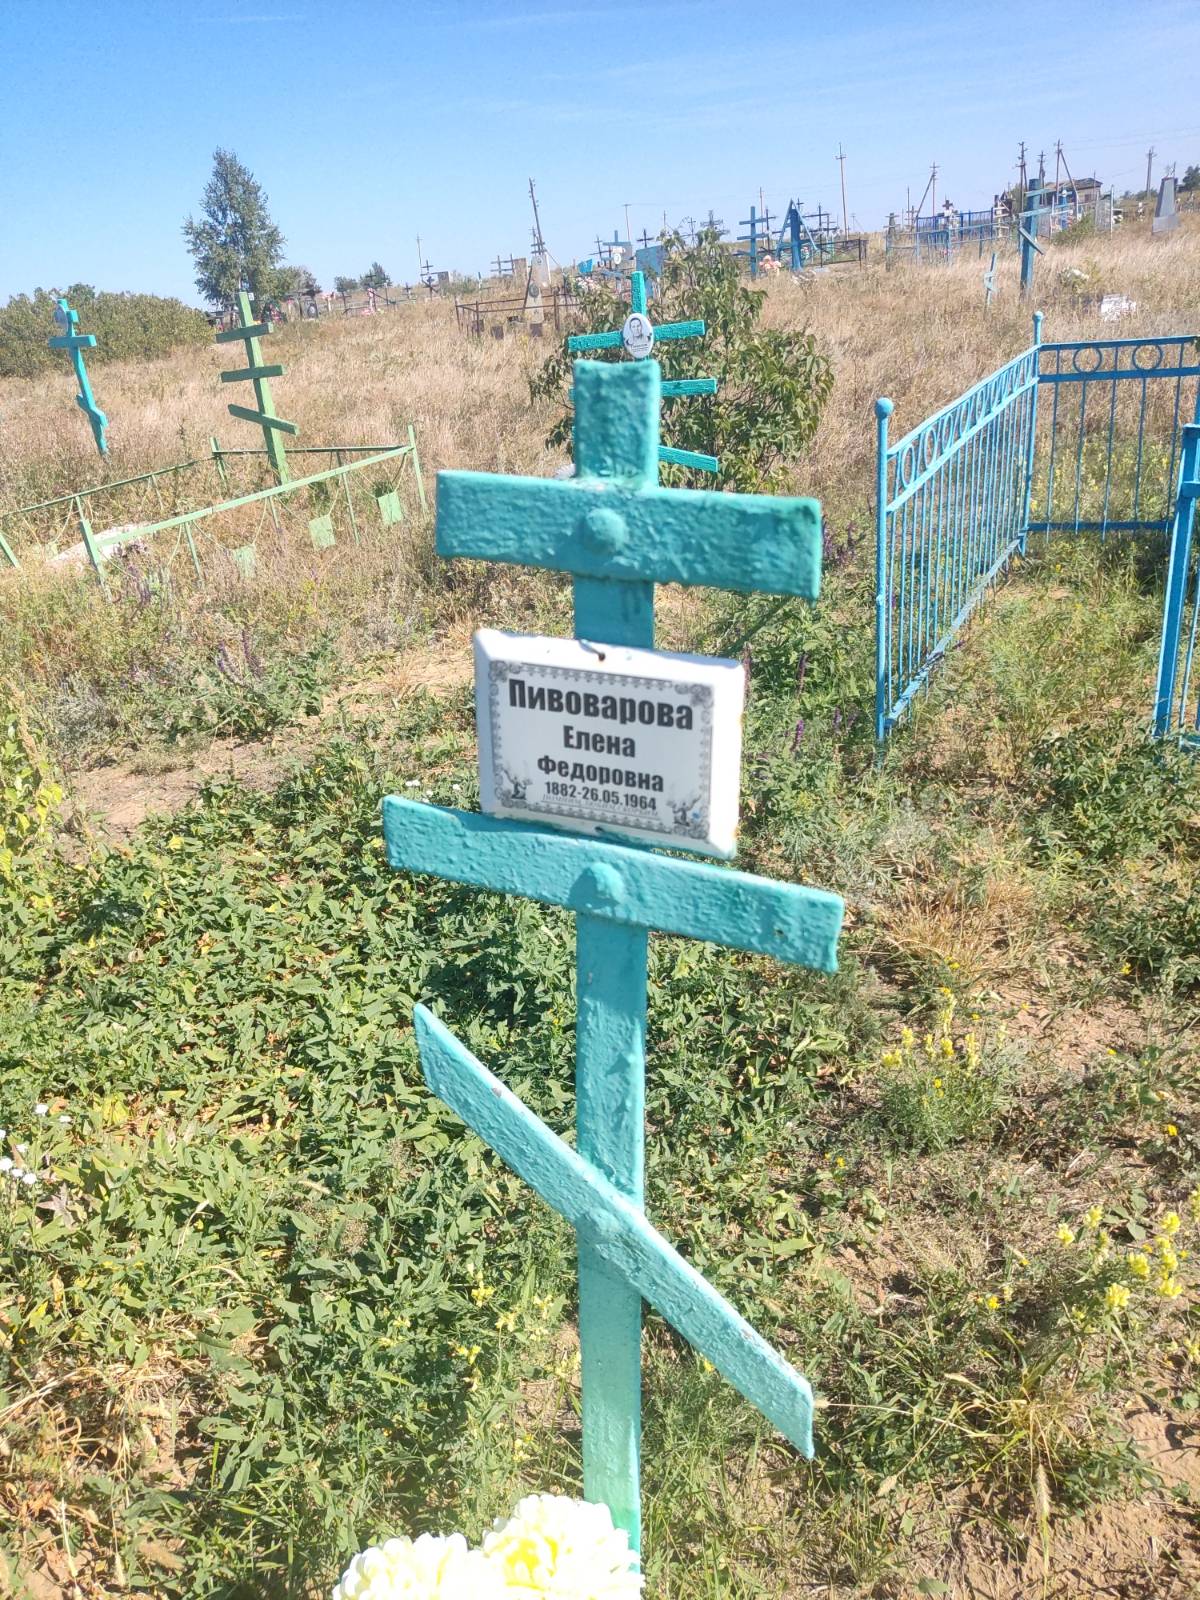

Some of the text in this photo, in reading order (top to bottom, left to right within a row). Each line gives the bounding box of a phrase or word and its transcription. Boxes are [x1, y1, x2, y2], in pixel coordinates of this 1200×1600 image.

[508, 678, 693, 731] Пивоварова
[562, 725, 636, 758] Елена
[537, 754, 664, 793] Федоровна
[545, 781, 657, 811] 1882-26.05.1964
